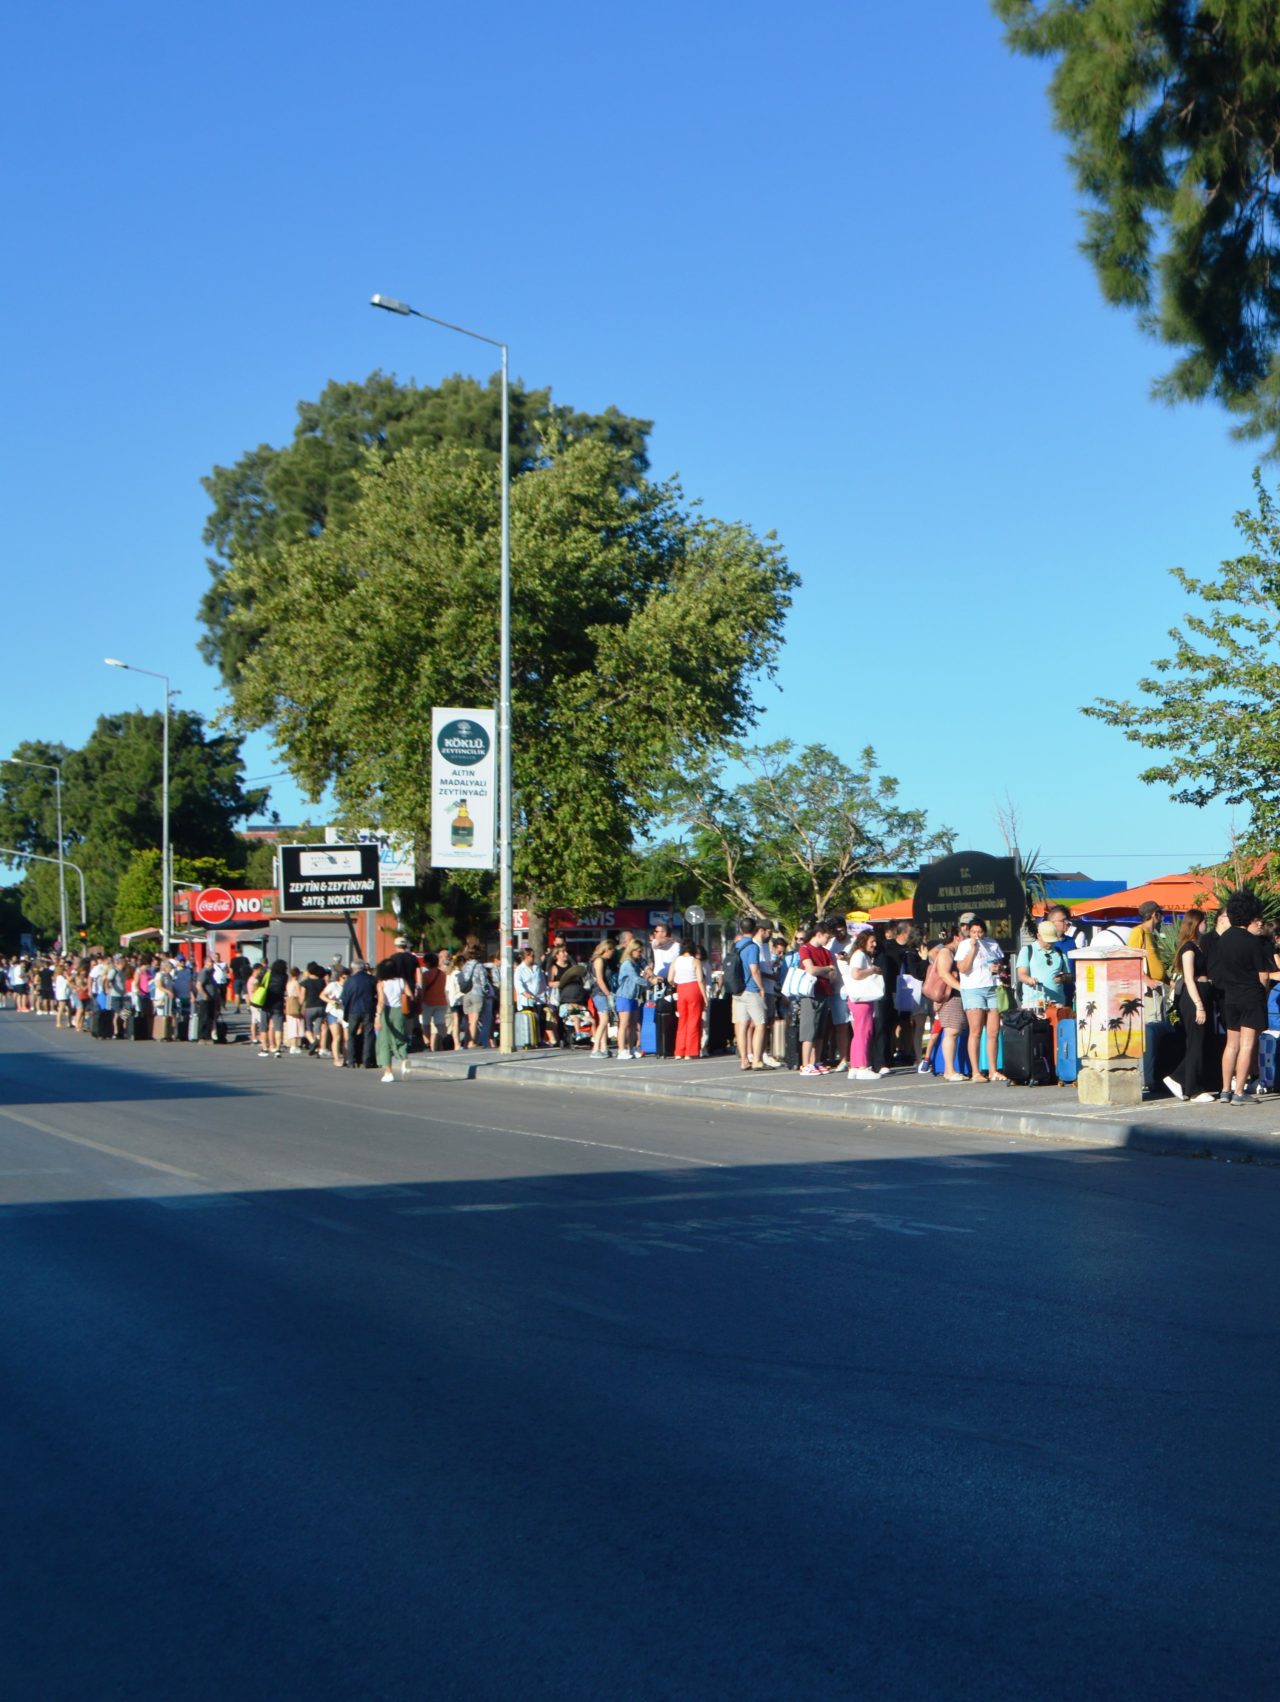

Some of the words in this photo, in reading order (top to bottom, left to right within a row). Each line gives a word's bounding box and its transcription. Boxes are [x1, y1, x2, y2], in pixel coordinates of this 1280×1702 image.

[440, 779, 487, 787] MADALYALI
[289, 880, 320, 893] ZEYTİN
[320, 882, 327, 891] &
[302, 895, 325, 908] SATIŞ
[327, 895, 363, 905] NOKTASI
